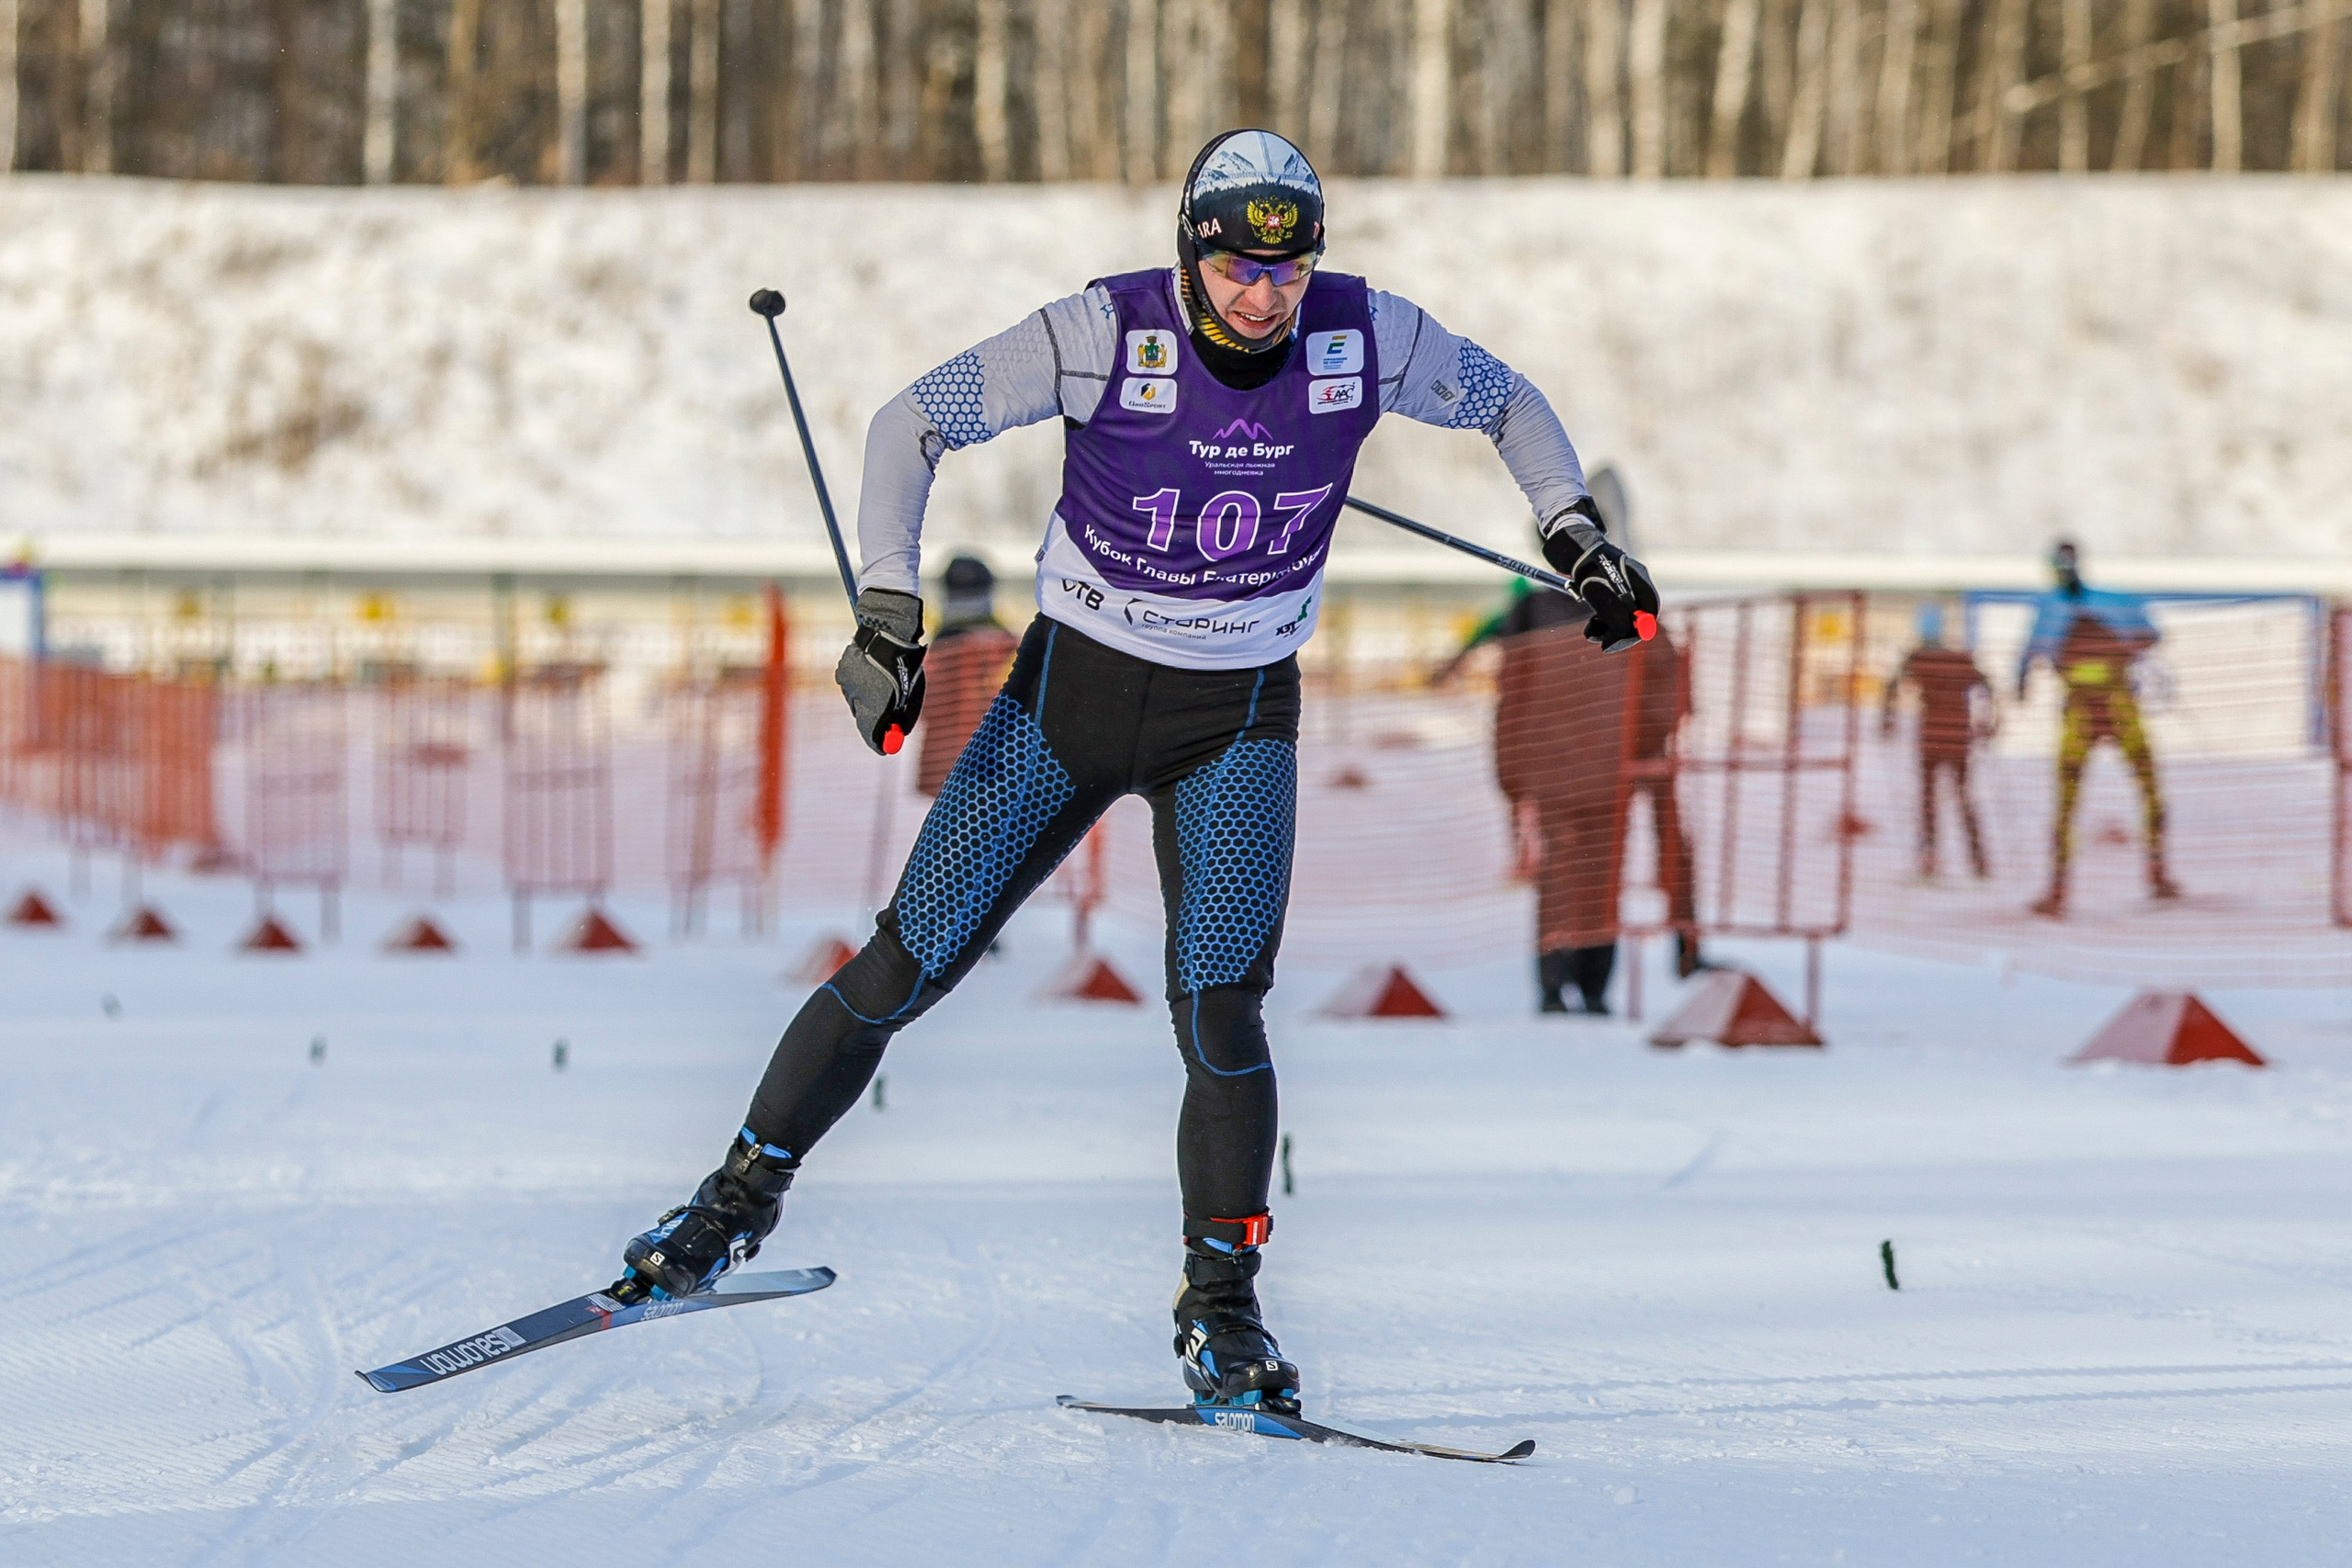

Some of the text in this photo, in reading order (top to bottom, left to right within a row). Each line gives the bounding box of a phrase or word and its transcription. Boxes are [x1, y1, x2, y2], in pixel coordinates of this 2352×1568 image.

[1189, 440, 1295, 458] Тур де Бург
[1133, 482, 1333, 562] 107
[1085, 524, 1132, 566] Кубок
[1136, 557, 1196, 584] Главы
